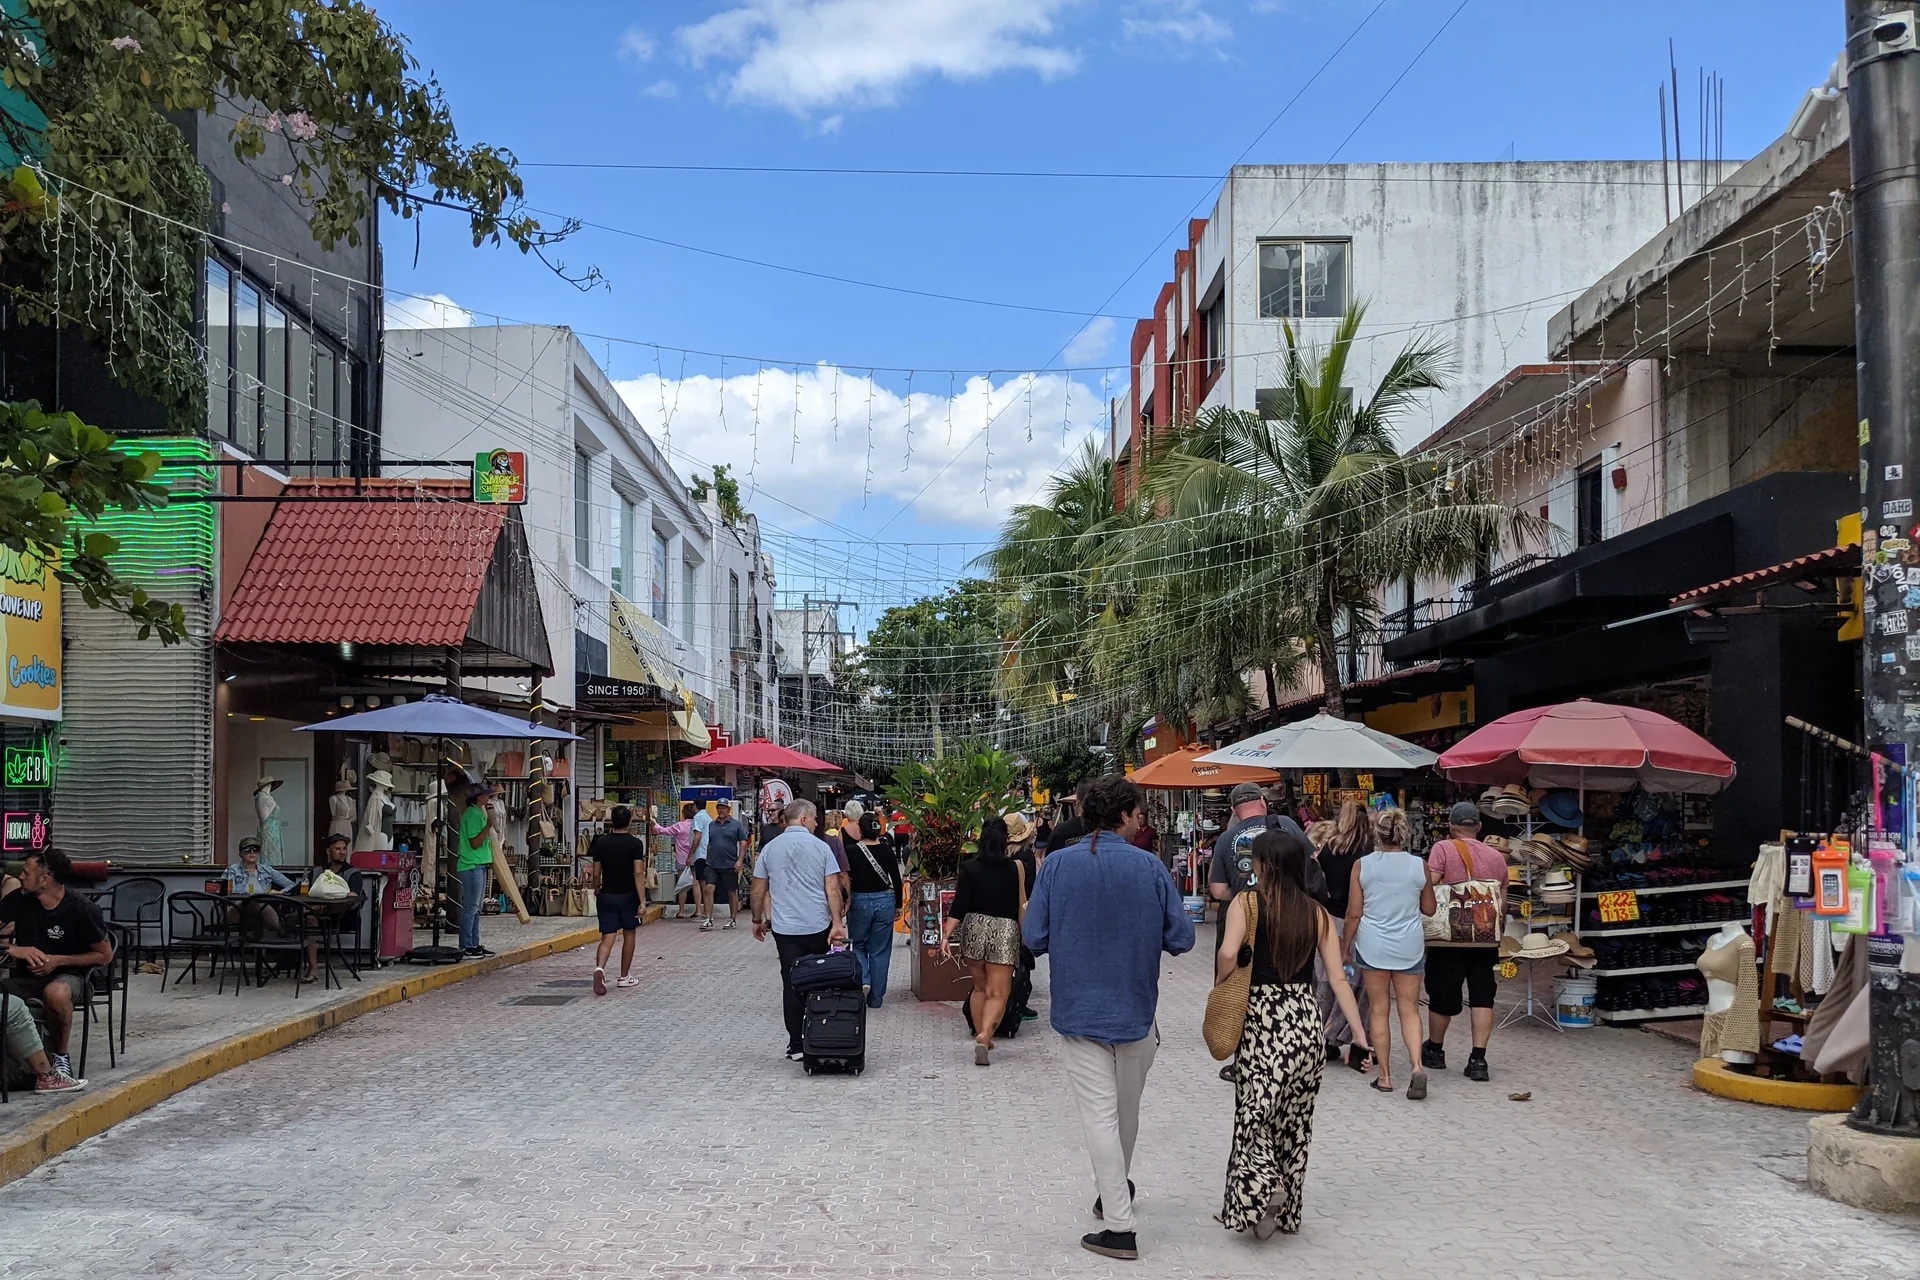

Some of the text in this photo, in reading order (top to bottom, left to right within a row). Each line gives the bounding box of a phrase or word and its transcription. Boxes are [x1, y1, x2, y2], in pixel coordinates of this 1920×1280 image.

[481, 471, 520, 485] SMOKE
[481, 485, 500, 494] SHOP
[9, 655, 56, 689] Cookies
[587, 684, 645, 696] SINCE 1950
[1230, 747, 1273, 759] ULTRA
[7, 822, 31, 840] HOOKAH
